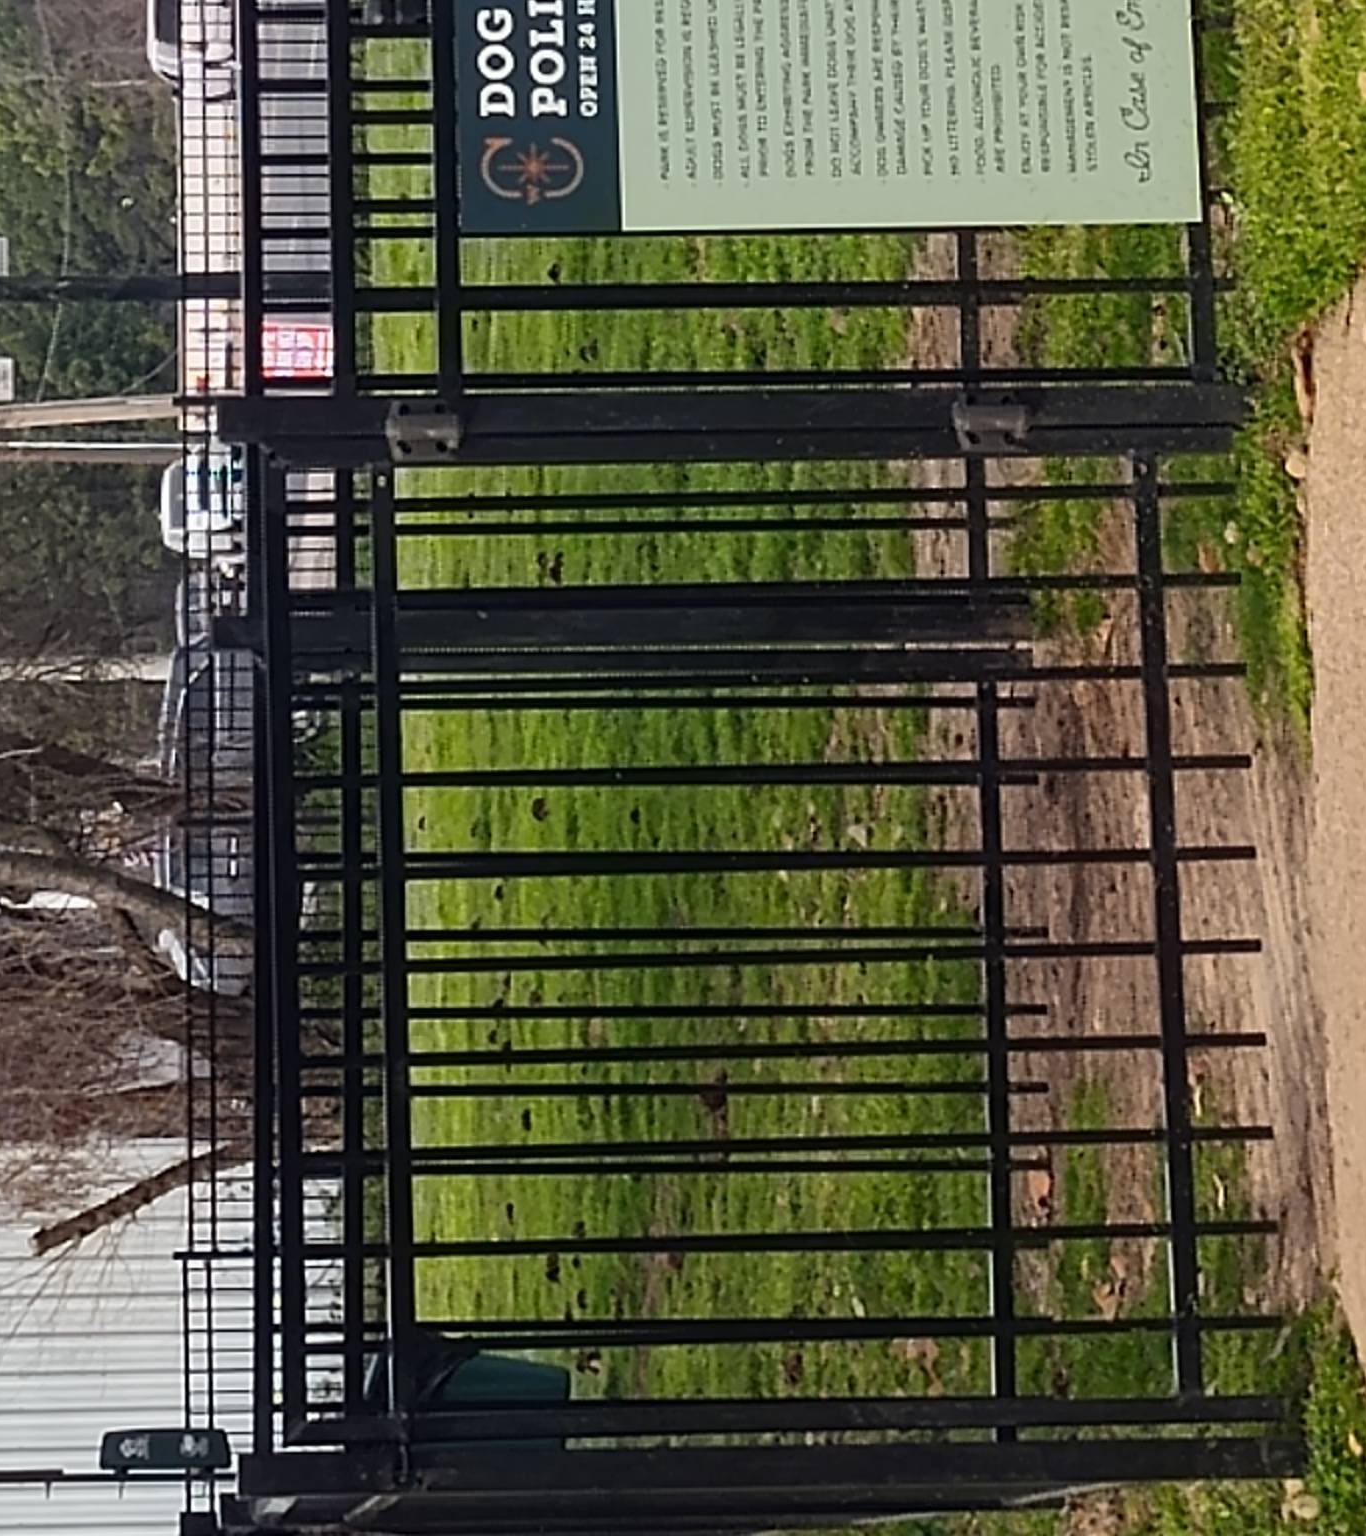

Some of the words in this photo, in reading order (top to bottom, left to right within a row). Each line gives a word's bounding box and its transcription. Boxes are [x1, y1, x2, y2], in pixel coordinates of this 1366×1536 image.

[577, 22, 598, 49] 24
[1121, 37, 1153, 64] of
[476, 7, 517, 118] DOG
[578, 54, 599, 118] OPEN
[1117, 72, 1150, 131] Case
[1122, 142, 1151, 184] In
